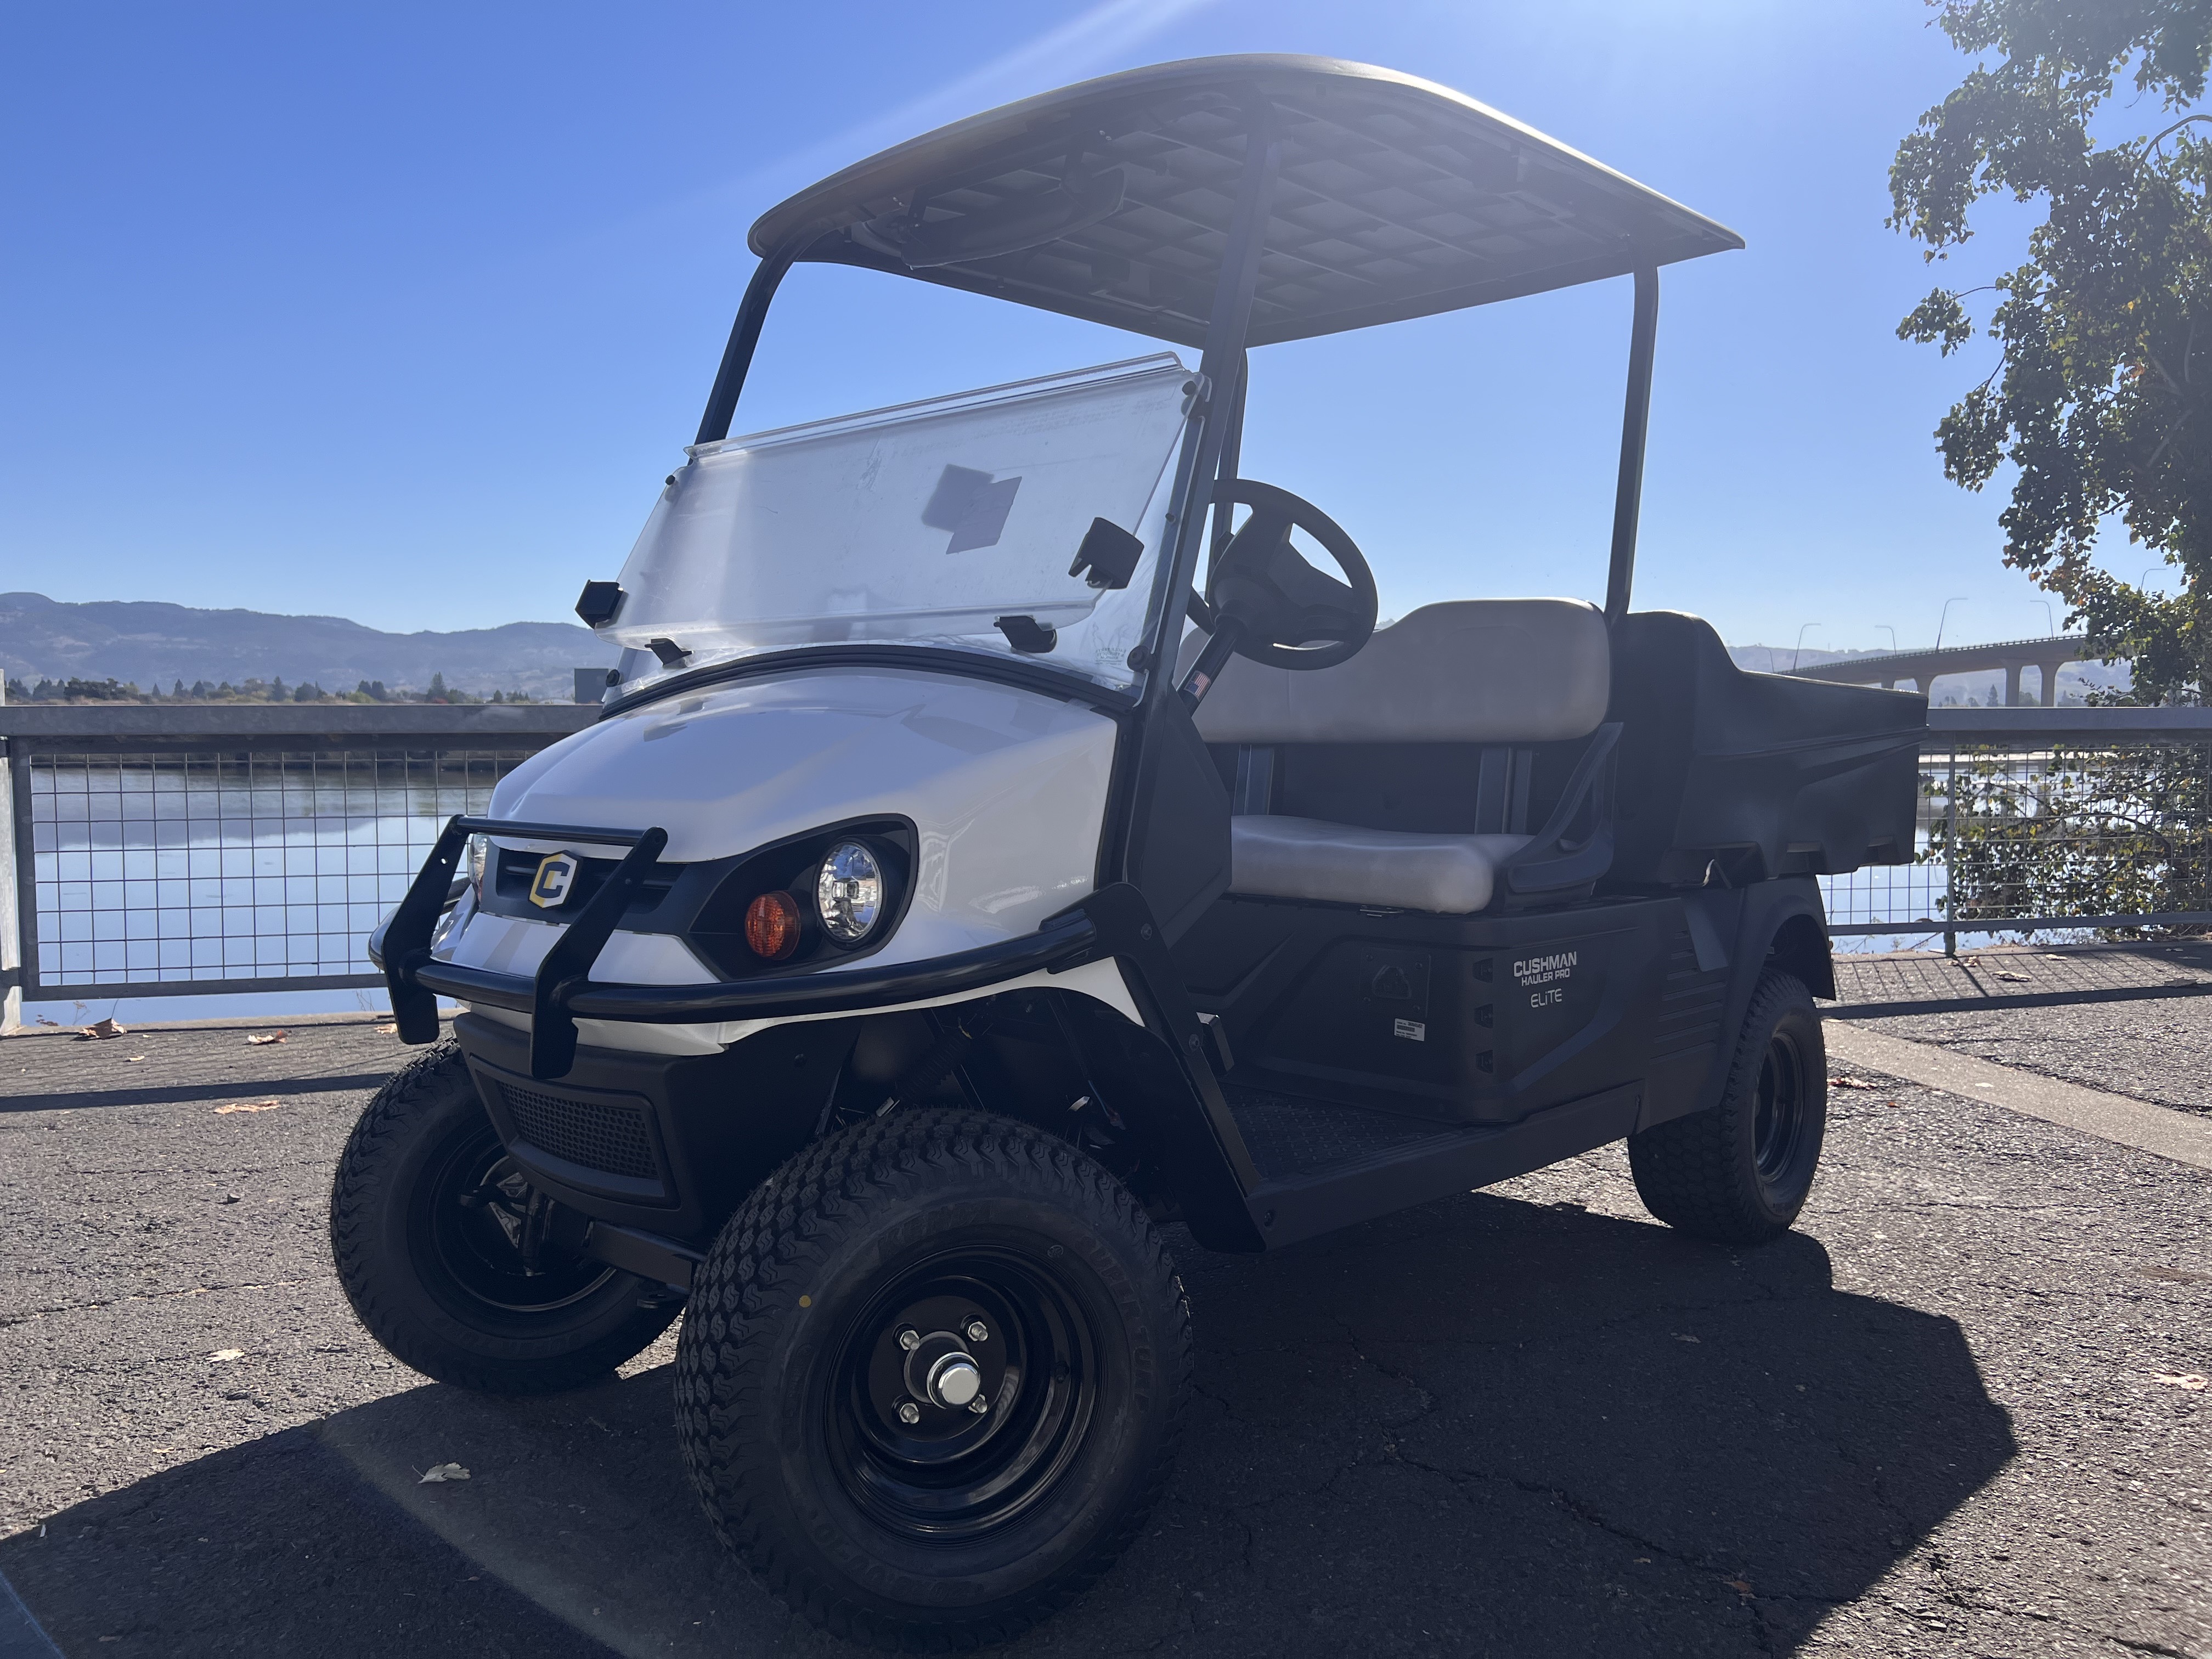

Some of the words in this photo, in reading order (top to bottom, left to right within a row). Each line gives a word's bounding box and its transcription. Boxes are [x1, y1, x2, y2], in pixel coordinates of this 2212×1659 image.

[1513, 951, 1577, 978] CUSHMAN
[1521, 972, 1553, 986] HAULER
[1555, 968, 1570, 979] PRO
